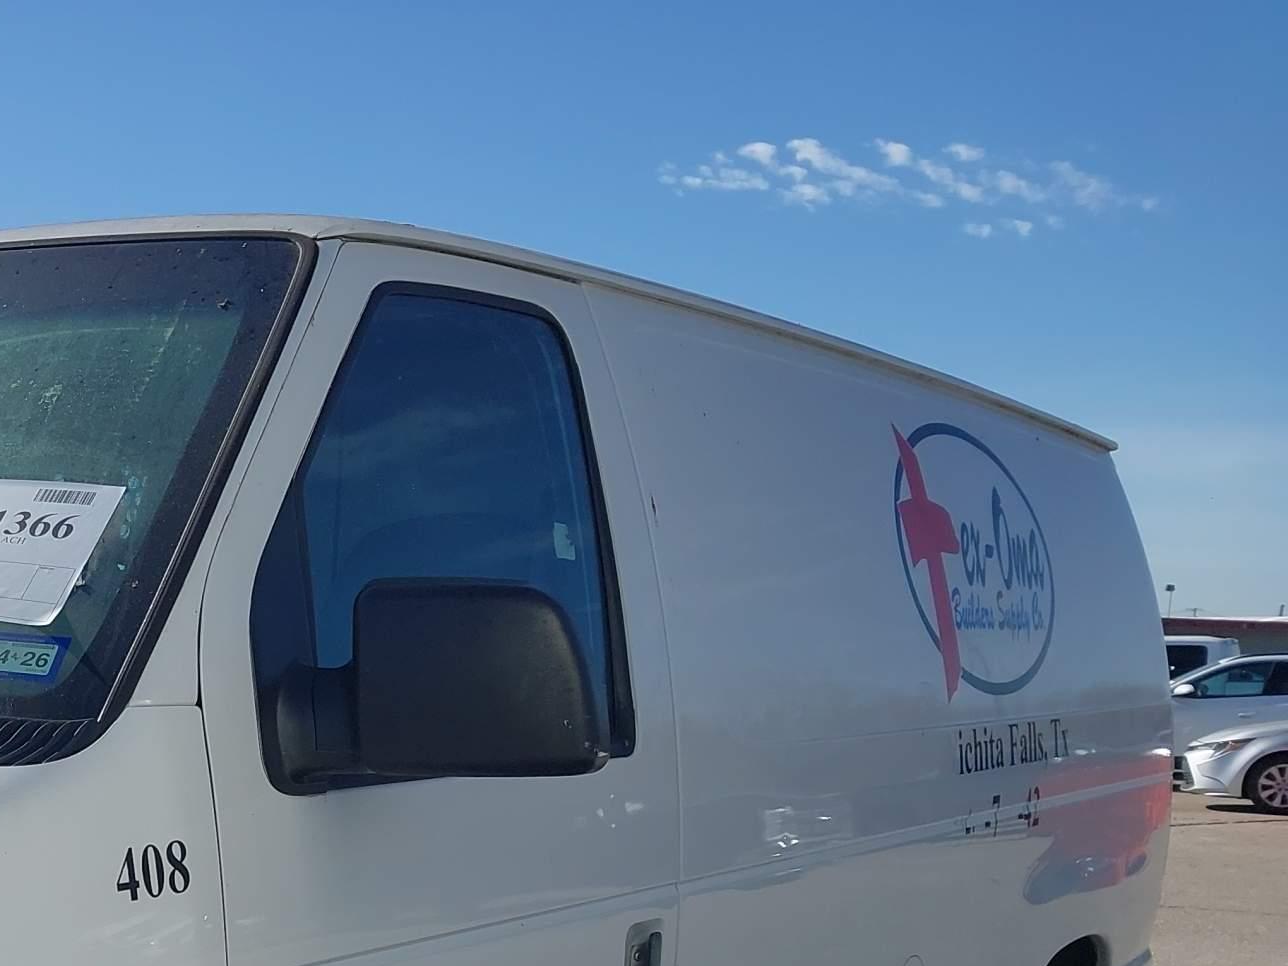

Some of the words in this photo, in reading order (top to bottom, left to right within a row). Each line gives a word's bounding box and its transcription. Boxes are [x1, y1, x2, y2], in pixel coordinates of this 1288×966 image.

[1, 536, 27, 545] ACH
[19, 651, 51, 669] 26
[116, 840, 191, 901] 408
